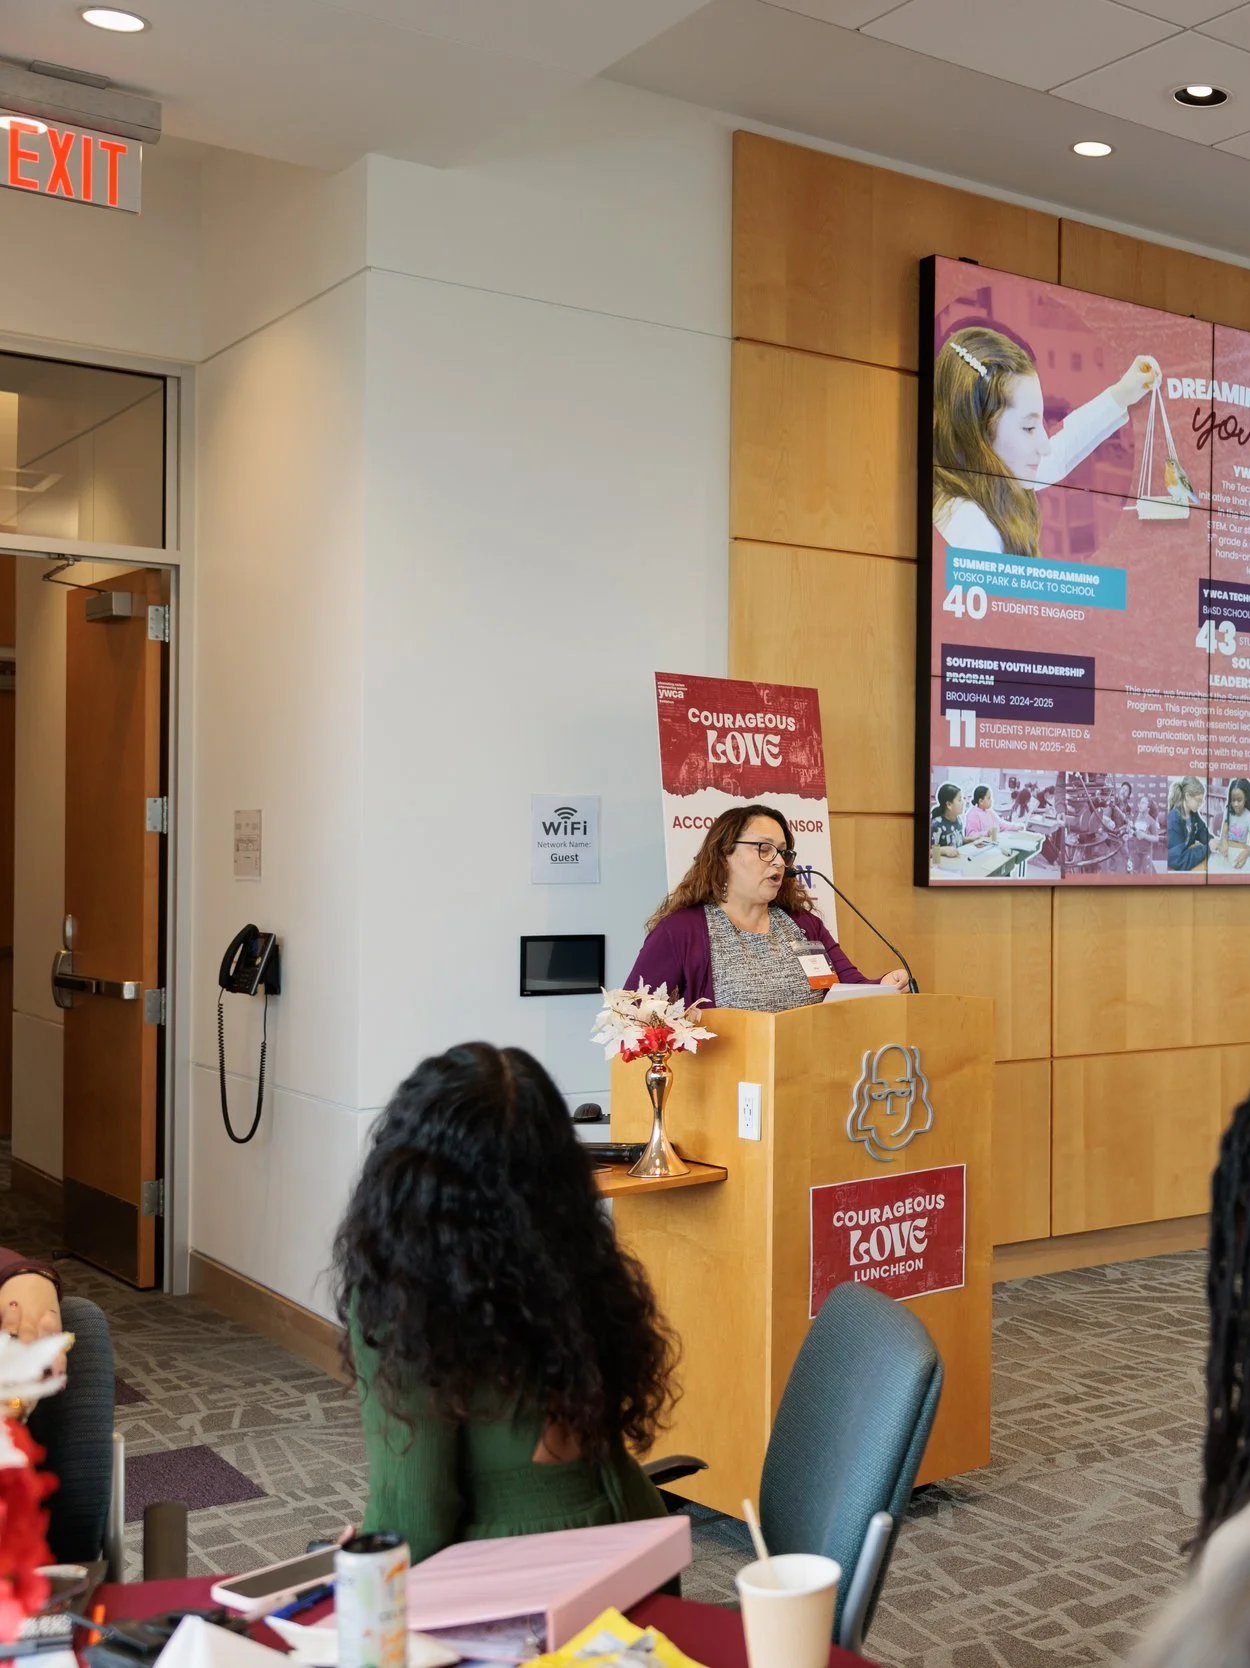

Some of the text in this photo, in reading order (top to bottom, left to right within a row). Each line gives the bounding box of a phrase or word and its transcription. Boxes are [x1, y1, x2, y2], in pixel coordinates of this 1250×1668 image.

[8, 120, 128, 207] EXIT
[1222, 481, 1235, 490] The
[1232, 496, 1247, 506] that
[1229, 524, 1242, 533] Our
[1219, 536, 1240, 547] grade
[953, 557, 1099, 585] SUMMER PARK PROGRAMMING
[953, 571, 1095, 597] YOSKO PARK & BACK TO SCHOOL
[943, 584, 1085, 621] 40 STUDENTS ENGAGED
[1203, 589, 1229, 601] YWCA
[1223, 607, 1250, 619] SCHOOL
[1196, 619, 1237, 656] 43
[946, 657, 1085, 677] SOUTHSIDE YOUTH LEADERSHIP
[946, 672, 994, 685] PROGRAM
[658, 689, 684, 698] ywca
[946, 691, 1053, 708] BROUGHAL MS 2024-2025
[1127, 701, 1163, 712] Program.
[1165, 703, 1180, 712] This
[1182, 705, 1215, 716] program
[1217, 707, 1223, 715] is
[688, 707, 796, 731] COURAGEOUS
[1157, 718, 1188, 727] graders
[1189, 719, 1204, 728] with
[1206, 721, 1239, 730] essential
[945, 708, 1090, 748] 11 STUDENTS PARTICIPATED &
[1132, 730, 1195, 742] communication,
[1197, 733, 1217, 742] team
[1219, 735, 1238, 744] work,
[707, 730, 782, 767] LOVE
[980, 738, 1077, 753] RETURNING IN 2025-26.
[1137, 744, 1174, 756] providing
[1191, 746, 1212, 756] Youth
[1189, 760, 1218, 771] change
[1220, 762, 1248, 771] makers
[542, 821, 587, 835] WiFi
[551, 853, 579, 862] Guest
[832, 1194, 945, 1227] COURAGEOUS
[850, 1216, 928, 1266] LOVE
[854, 1258, 924, 1282] LUNCHEON
